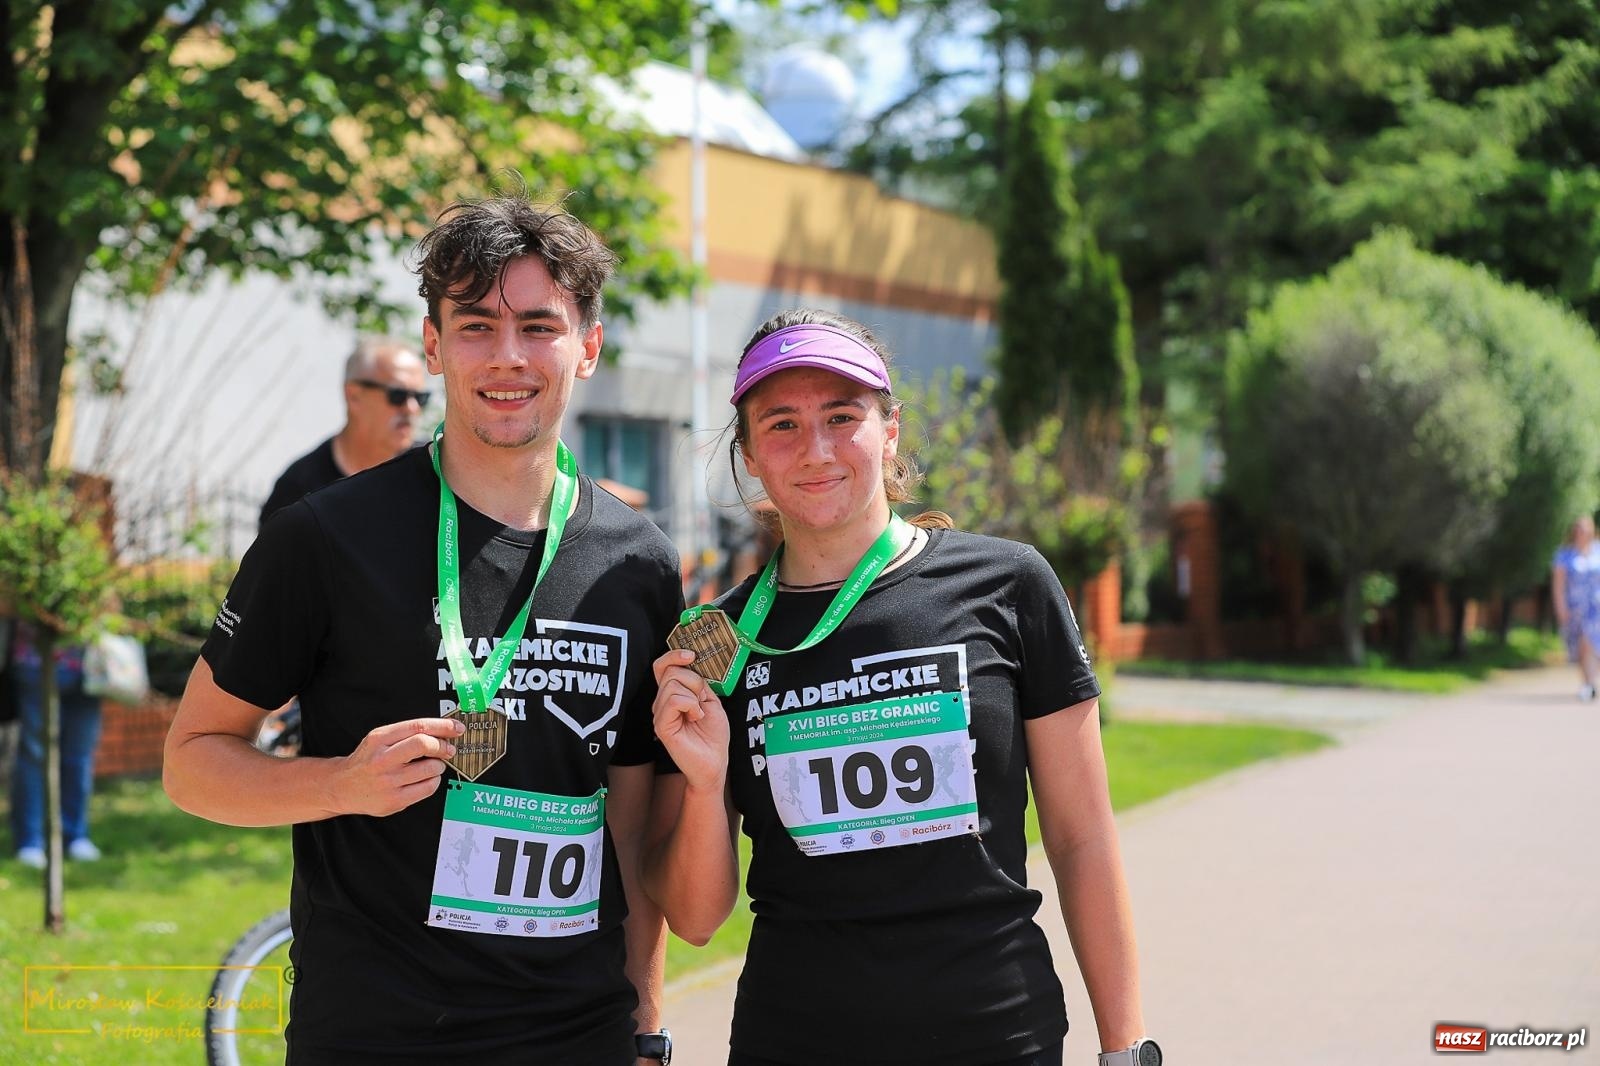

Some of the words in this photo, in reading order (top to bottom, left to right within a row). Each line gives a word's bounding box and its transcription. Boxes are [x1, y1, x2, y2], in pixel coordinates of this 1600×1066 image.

[445, 517, 454, 567] Racibórz
[692, 620, 719, 639] POLICJA
[436, 637, 609, 667] AMICKIE
[483, 647, 510, 690] Racibórz
[437, 668, 611, 697] MRZOSTWA
[746, 663, 940, 722] AKADEMICKIE
[439, 698, 527, 721] PSKI
[788, 718, 813, 733] XVI
[816, 712, 849, 729] BIEG
[851, 708, 879, 724] BEZ
[880, 700, 941, 718] GRANIC
[468, 722, 498, 731] POLICJA
[831, 728, 842, 736] im.
[844, 726, 859, 736] asp.
[860, 722, 890, 732] Michała
[890, 716, 941, 729] Kędzierskiego
[852, 734, 869, 743] maja
[869, 732, 884, 740] 2024
[808, 744, 935, 815] 109
[473, 791, 500, 804] XVI
[503, 795, 538, 811] BIEG
[541, 801, 567, 815] BEZ
[530, 815, 545, 823] asp.
[546, 816, 573, 825] Michała
[838, 818, 879, 830] KATEGORIA:
[880, 816, 896, 826] Bieg
[897, 814, 915, 823] OPEN
[912, 823, 952, 836] Racibórz
[493, 836, 586, 899] 110
[449, 913, 472, 921] POLICJA
[496, 906, 536, 915] KATEGORIA:
[537, 909, 550, 917] Bieg
[559, 920, 585, 929] Racibórz
